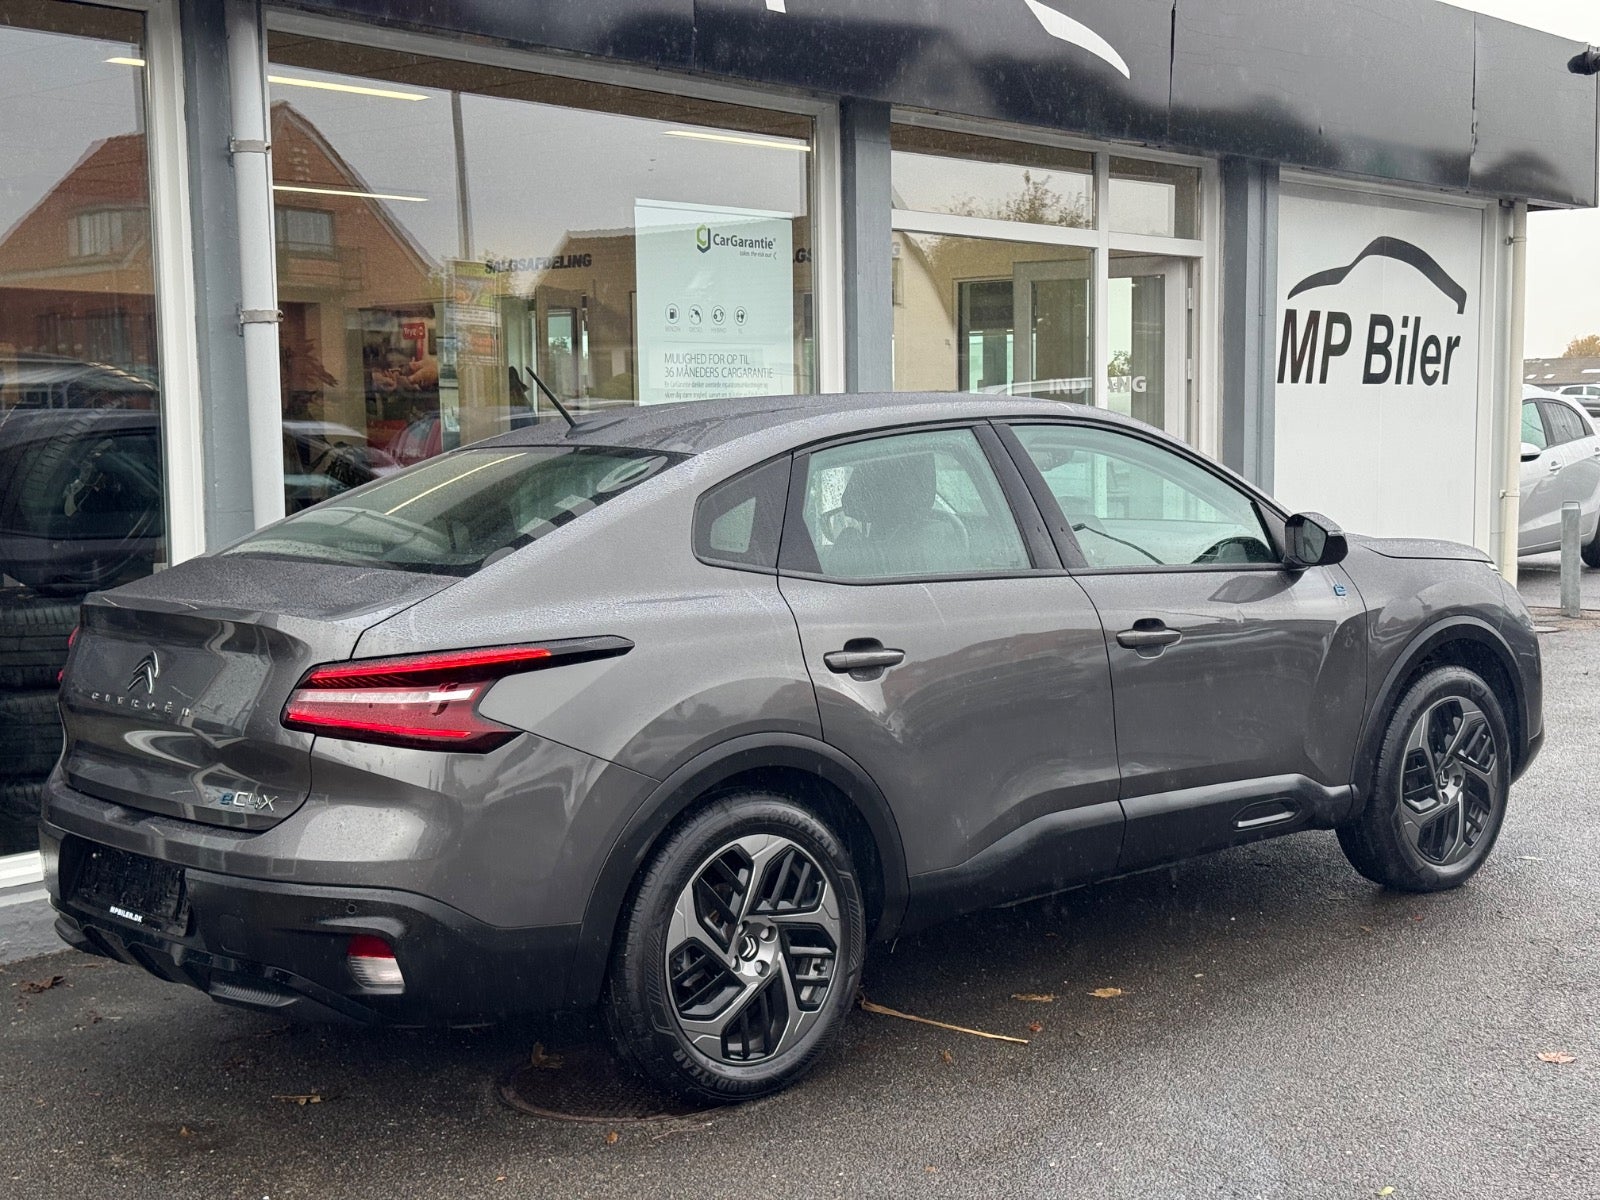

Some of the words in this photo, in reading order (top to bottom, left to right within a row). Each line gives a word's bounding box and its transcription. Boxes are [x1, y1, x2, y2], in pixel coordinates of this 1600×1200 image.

[1277, 308, 1352, 384] MP
[1362, 313, 1461, 386] Biler
[664, 352, 707, 365] MULIGHED
[708, 353, 725, 365] FOR
[726, 354, 738, 365] OP
[740, 354, 750, 365] TIL
[664, 366, 675, 378] 36
[676, 365, 720, 378] MÅNEDERS
[721, 367, 774, 379] CARGARANTIE
[1048, 375, 1147, 395] INDANG
